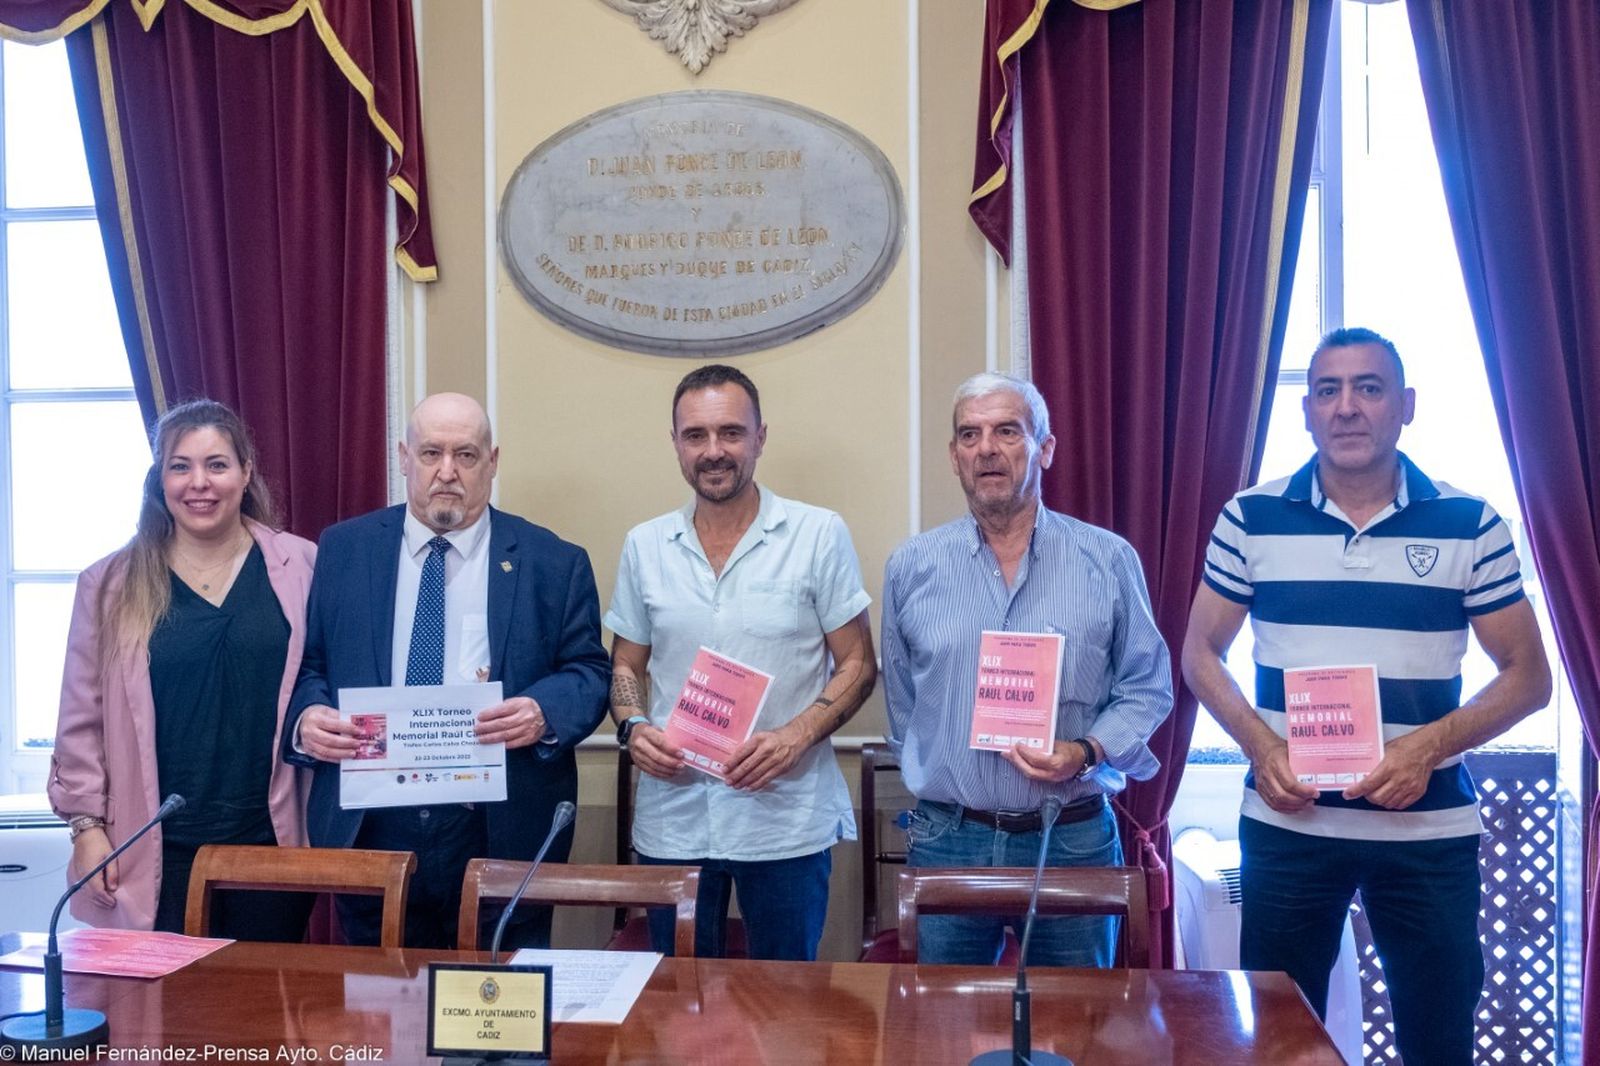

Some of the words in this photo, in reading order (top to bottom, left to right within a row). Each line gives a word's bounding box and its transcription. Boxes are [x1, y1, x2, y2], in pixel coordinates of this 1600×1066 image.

[727, 152, 748, 170] DE
[568, 234, 588, 254] DE
[760, 228, 781, 246] DE
[675, 260, 727, 280] DUQUE
[736, 260, 756, 274] DE
[585, 288, 610, 307] QUE
[662, 306, 678, 322] DE
[683, 307, 714, 323] ESTA
[982, 655, 1002, 668] XLIX
[690, 669, 710, 686] XLIX
[980, 675, 1035, 689] MEMORIAL
[683, 686, 735, 717] MEMORIAL
[978, 687, 1002, 700] RAUL
[1004, 688, 1035, 703] CALVO
[1288, 691, 1311, 705] XLIX
[412, 708, 435, 717] XLIX
[437, 707, 472, 717] Torneo
[678, 698, 701, 718] RAUL
[701, 708, 730, 729] CALVO
[1290, 710, 1353, 724] MEMORIAL
[409, 718, 475, 729] Internacional
[392, 731, 439, 741] Memorial
[441, 730, 463, 740] Raúl
[1291, 726, 1317, 738] RAUL
[1321, 724, 1355, 737] CALVO
[442, 1008, 472, 1017] EXCMO.
[474, 1009, 537, 1019] AYUNTAMIENTO
[483, 1020, 494, 1028] DE
[477, 1031, 501, 1040] CADIZ
